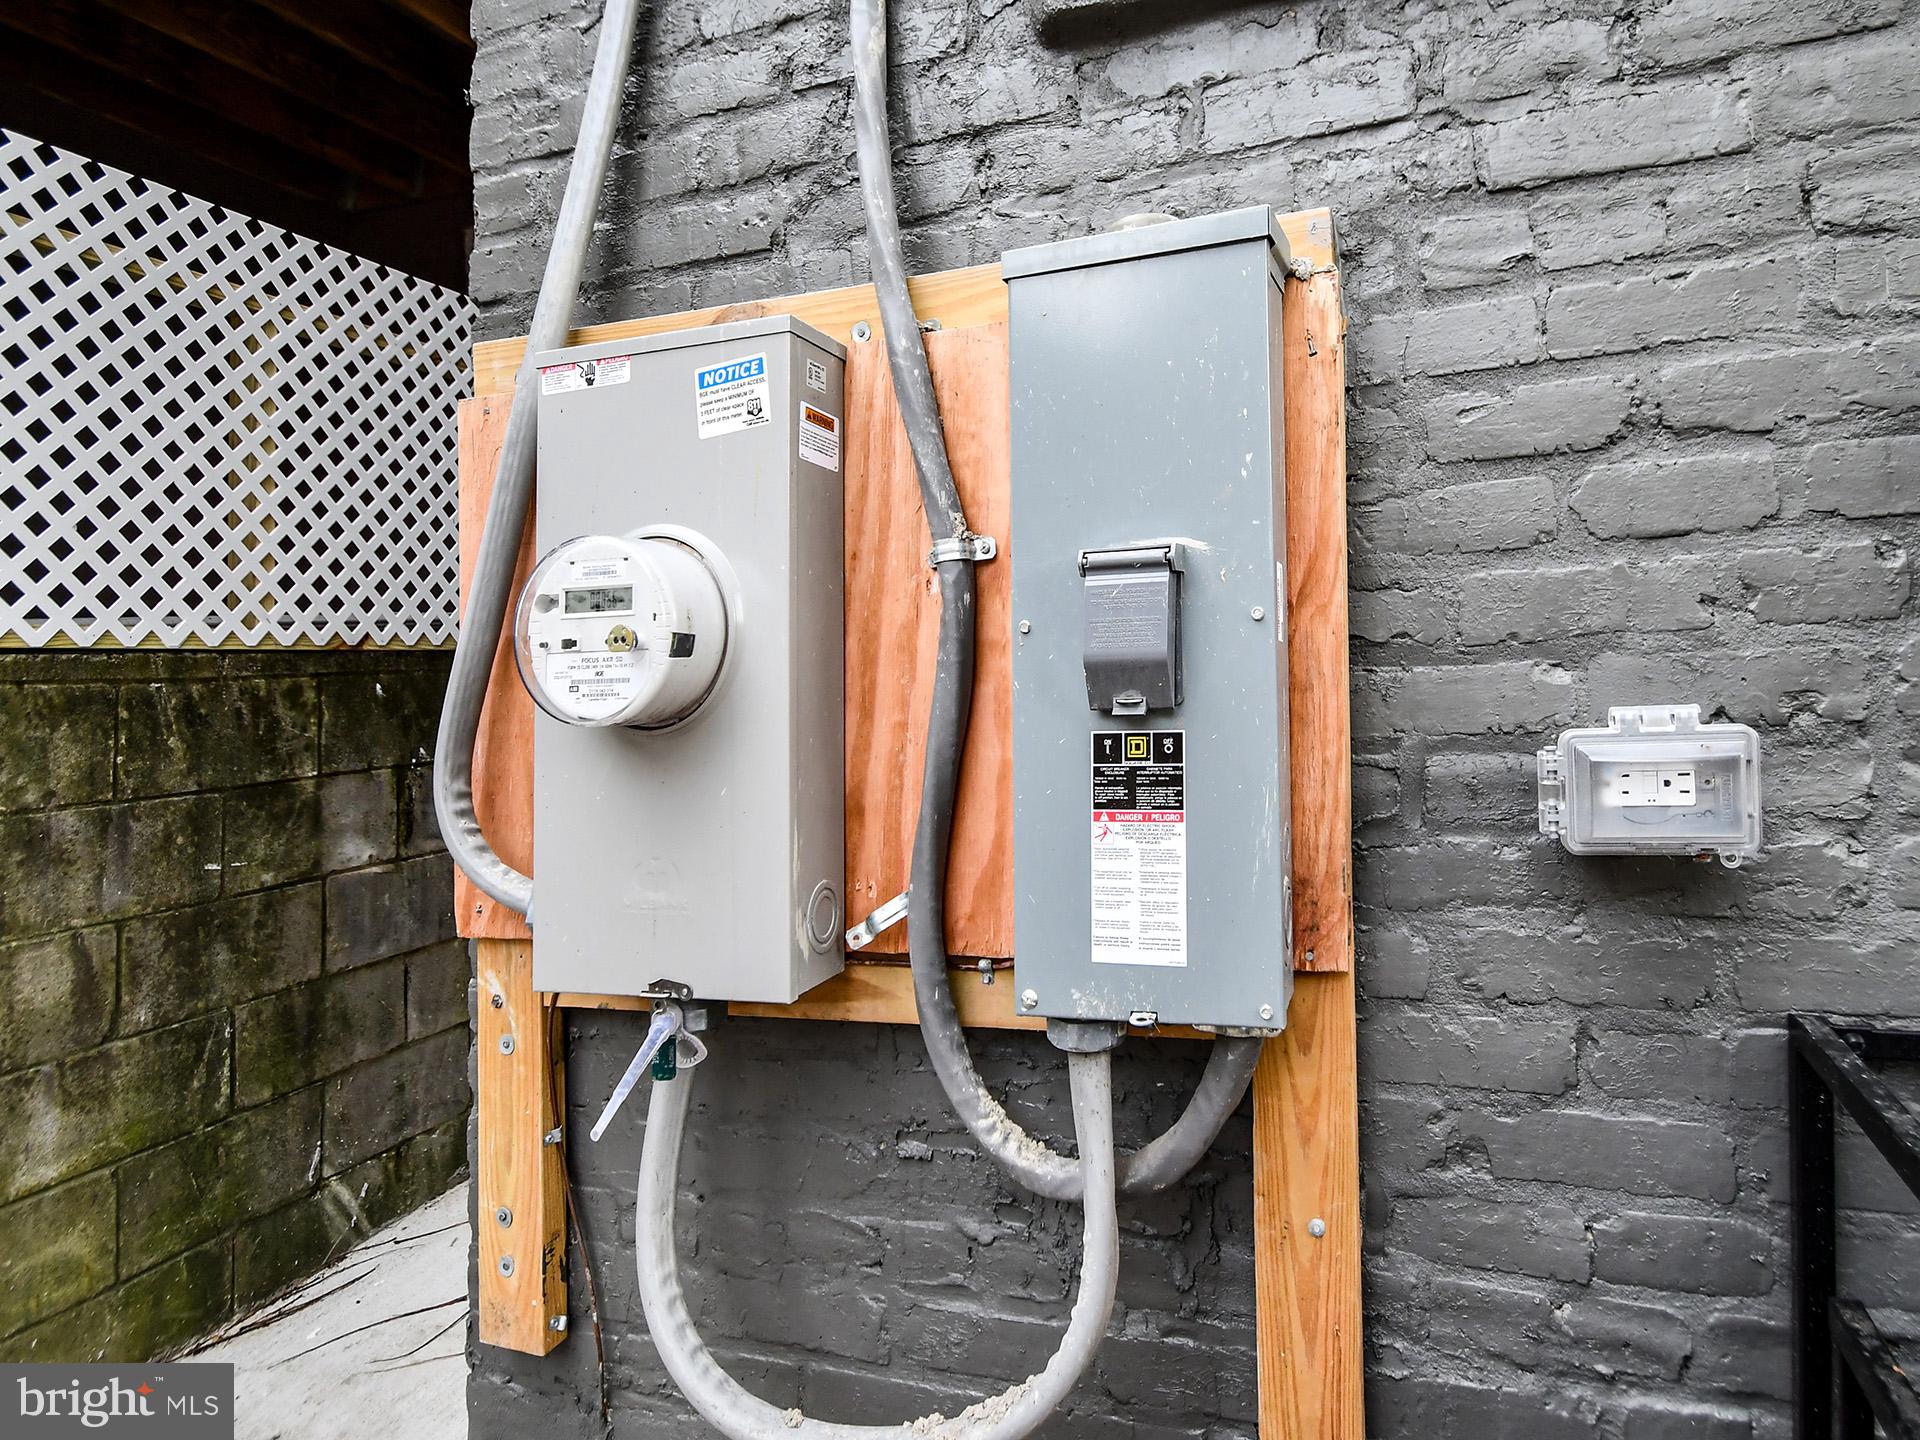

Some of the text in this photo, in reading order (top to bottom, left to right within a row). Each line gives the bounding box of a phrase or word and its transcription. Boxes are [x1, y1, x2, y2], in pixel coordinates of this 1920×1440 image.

[703, 360, 760, 386] NOTICE
[731, 382, 746, 390] CLEAR
[728, 391, 748, 400] MINIMUM
[747, 397, 760, 412] 811
